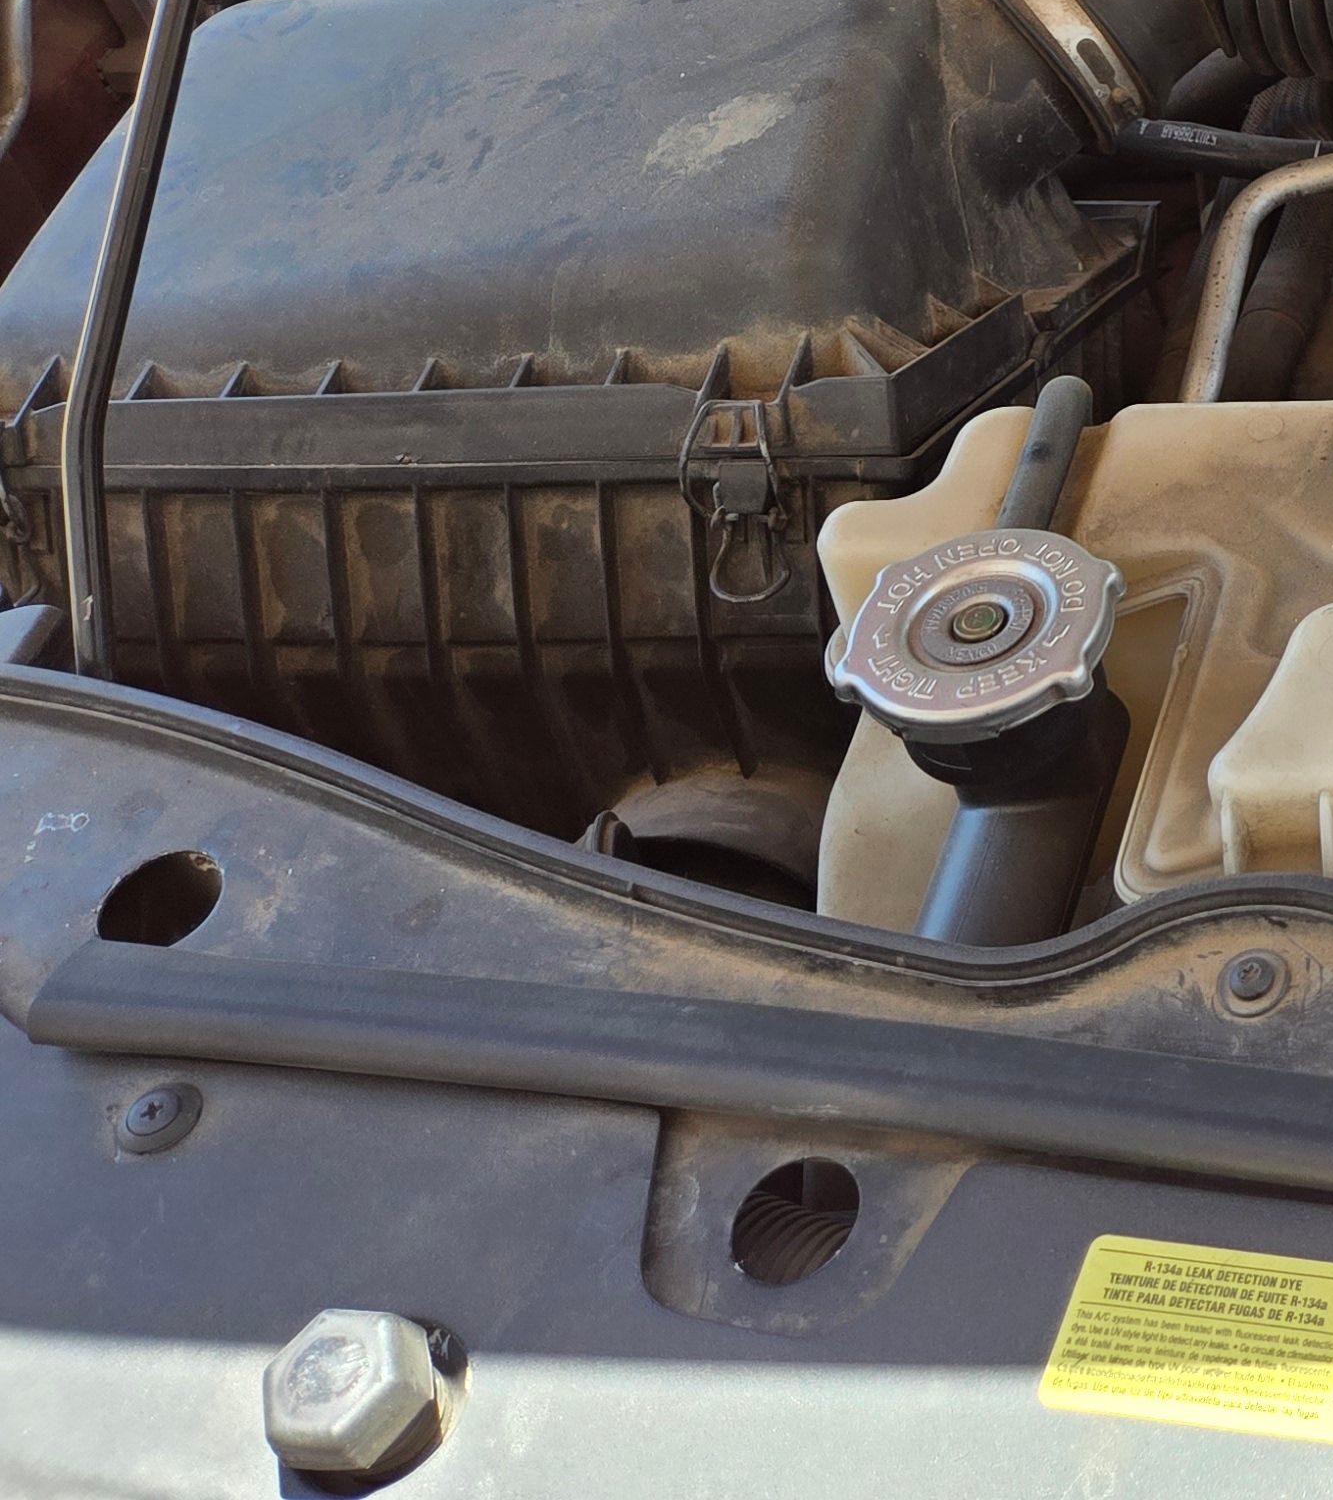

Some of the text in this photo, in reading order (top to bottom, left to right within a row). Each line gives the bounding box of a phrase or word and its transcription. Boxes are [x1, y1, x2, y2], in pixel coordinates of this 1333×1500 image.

[933, 537, 1023, 571] OPEN
[1023, 541, 1080, 581] NOT
[877, 566, 933, 615] HOT
[1060, 578, 1088, 614] DO
[868, 650, 1048, 700] KEEP TIGHT
[1109, 1273, 1328, 1309] TEINTURE DE DÉTECTION DE FUITE R-134a
[1145, 1262, 1303, 1290] R-134a LEAK DETECTION DYE
[1103, 1288, 1325, 1325] TINTE PARA DETECTAR FUGAS DE R-134a
[1077, 1310, 1093, 1318] This
[1095, 1312, 1111, 1320] A/C
[1113, 1315, 1141, 1326] system
[1145, 1319, 1158, 1327] has
[1162, 1321, 1181, 1329] been
[1184, 1324, 1213, 1334] treated
[1216, 1328, 1232, 1336] with
[1284, 1337, 1300, 1345] leak
